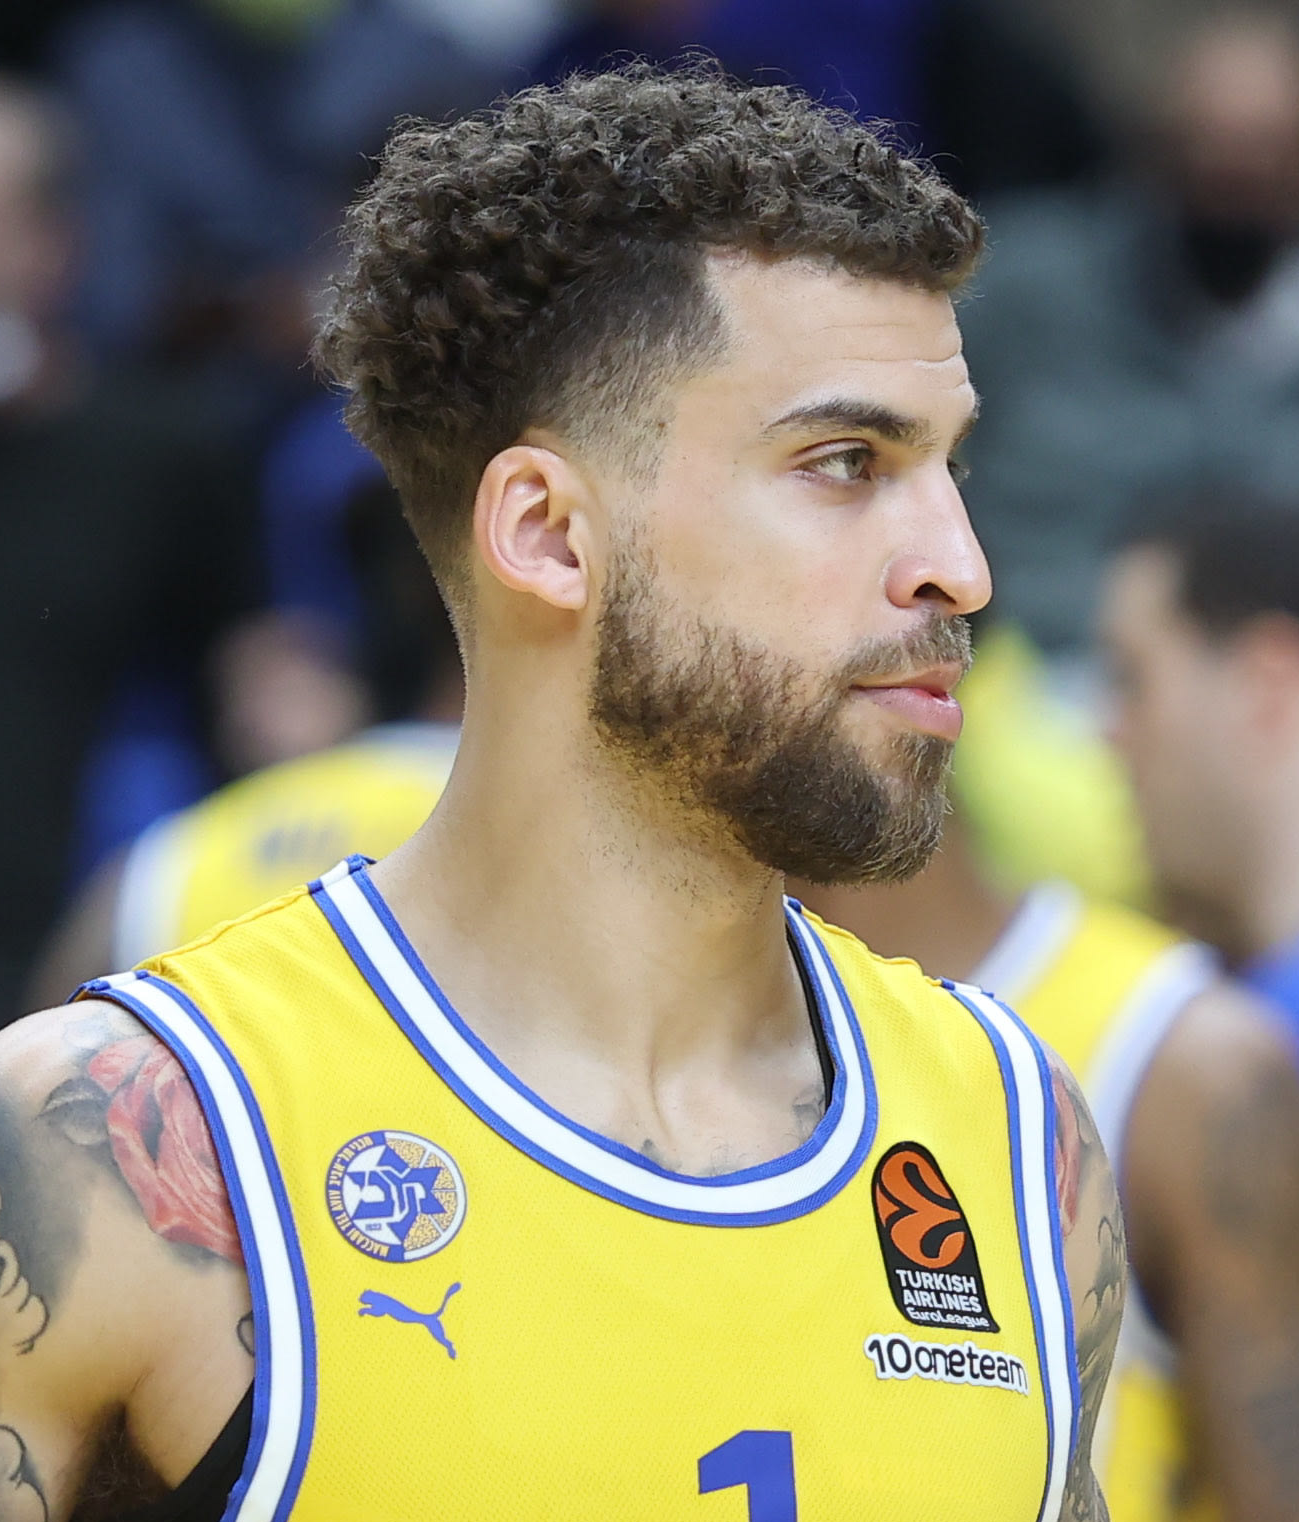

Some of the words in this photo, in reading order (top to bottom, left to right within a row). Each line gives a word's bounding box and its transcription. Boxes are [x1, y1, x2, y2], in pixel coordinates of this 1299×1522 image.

[327, 1188, 344, 1212] AVIV
[334, 1211, 352, 1232] TEL
[345, 1227, 390, 1258] MACCABI
[895, 1269, 978, 1295] TURKISH
[903, 1289, 983, 1314] AIRLINES
[906, 1307, 990, 1328] EuroLeague
